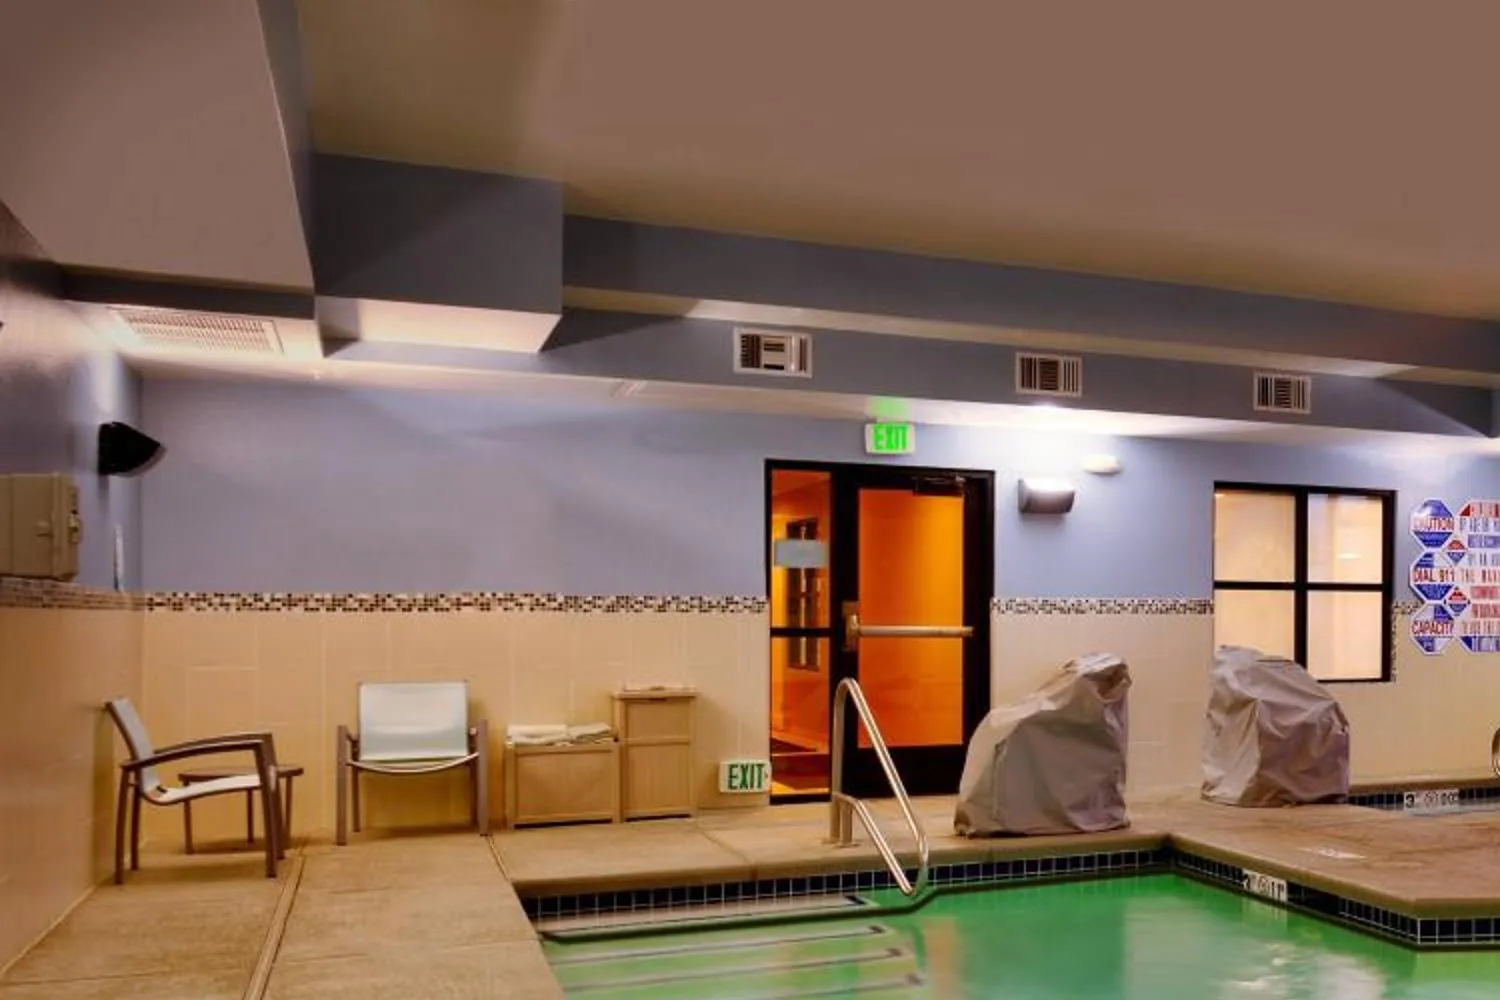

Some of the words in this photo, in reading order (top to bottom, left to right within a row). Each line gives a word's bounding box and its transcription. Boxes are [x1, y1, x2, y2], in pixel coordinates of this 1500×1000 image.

[874, 424, 907, 450] EXIT
[1414, 568, 1437, 582] DIAL
[1440, 568, 1455, 582] 911
[1412, 620, 1455, 636] CAPACITY
[727, 763, 765, 790] EXIT
